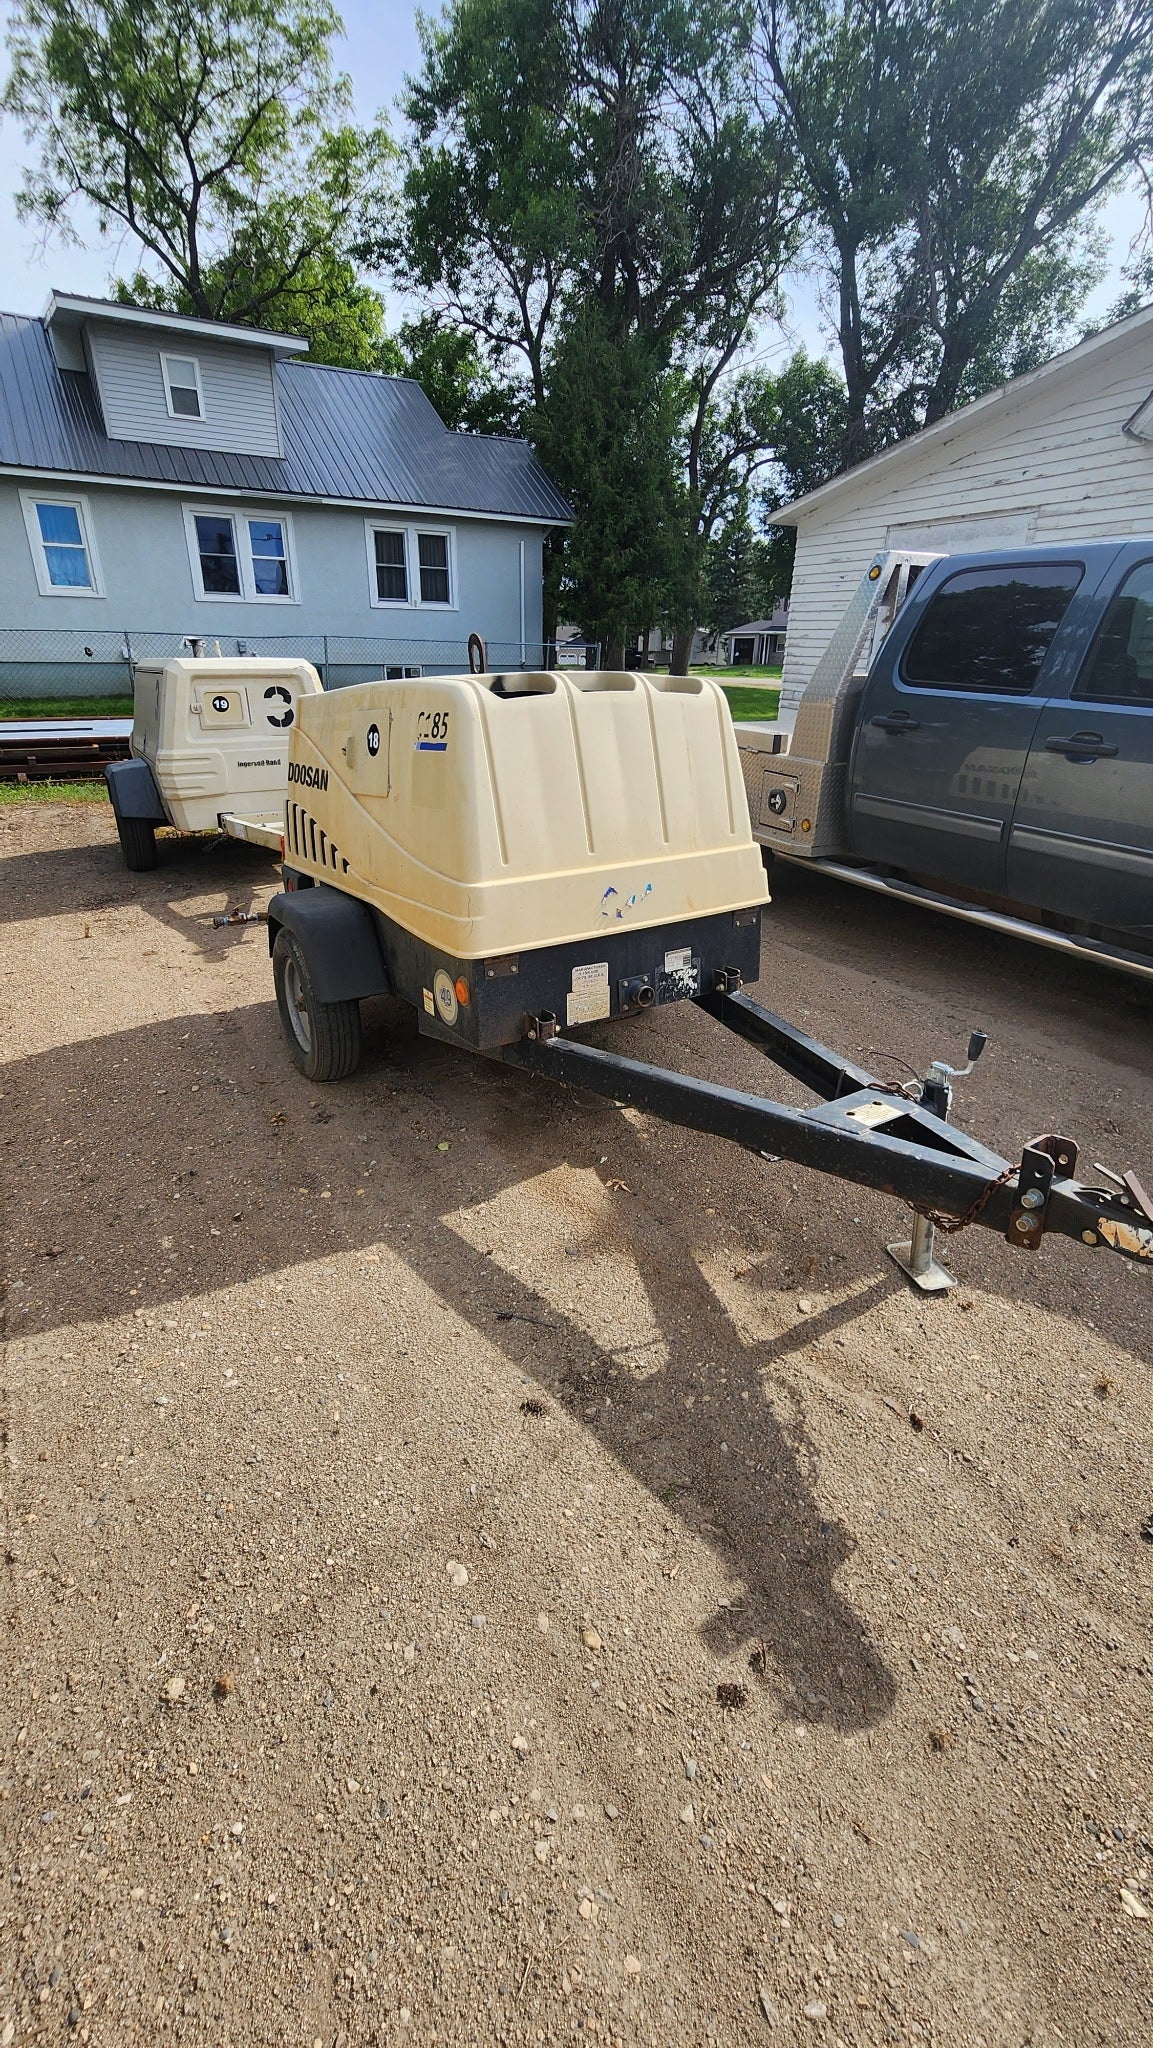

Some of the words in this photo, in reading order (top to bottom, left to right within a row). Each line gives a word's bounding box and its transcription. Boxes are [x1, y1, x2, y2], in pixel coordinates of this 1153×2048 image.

[213, 699, 228, 709] 19
[417, 711, 449, 740] 85
[368, 732, 379, 749] 18
[288, 762, 329, 791] DOOSAN
